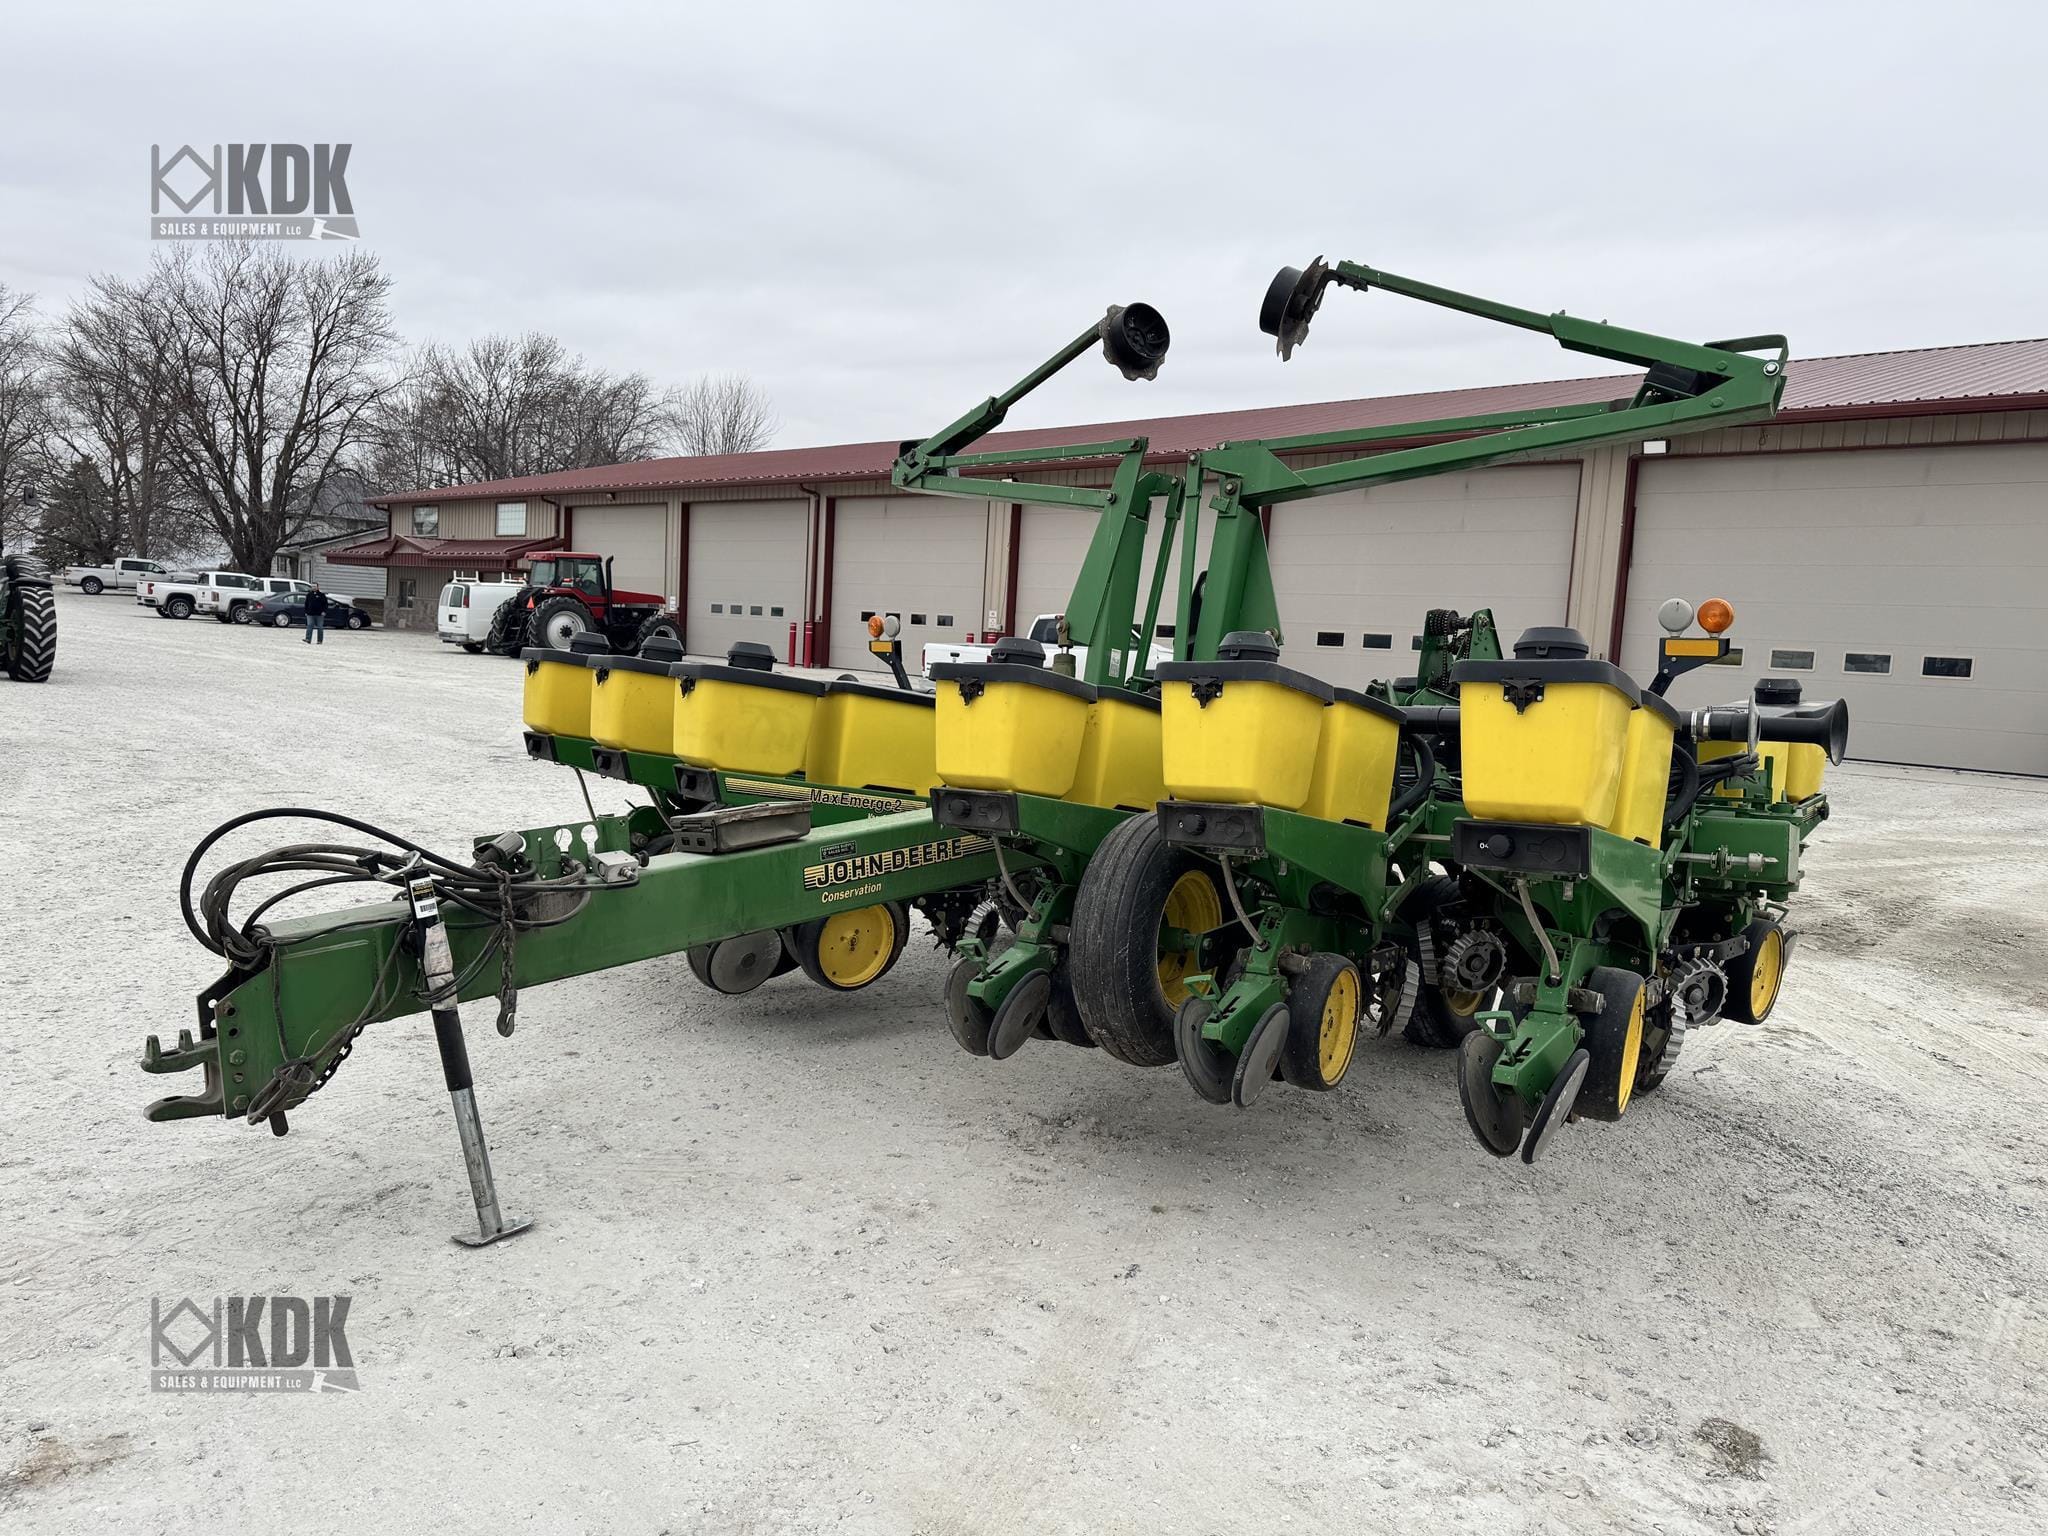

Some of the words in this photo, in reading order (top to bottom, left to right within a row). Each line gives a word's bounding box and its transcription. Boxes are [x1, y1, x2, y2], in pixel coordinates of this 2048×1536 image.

[816, 853, 885, 887] JOHN
[892, 838, 963, 871] DEERE
[821, 882, 882, 904] Conservation
